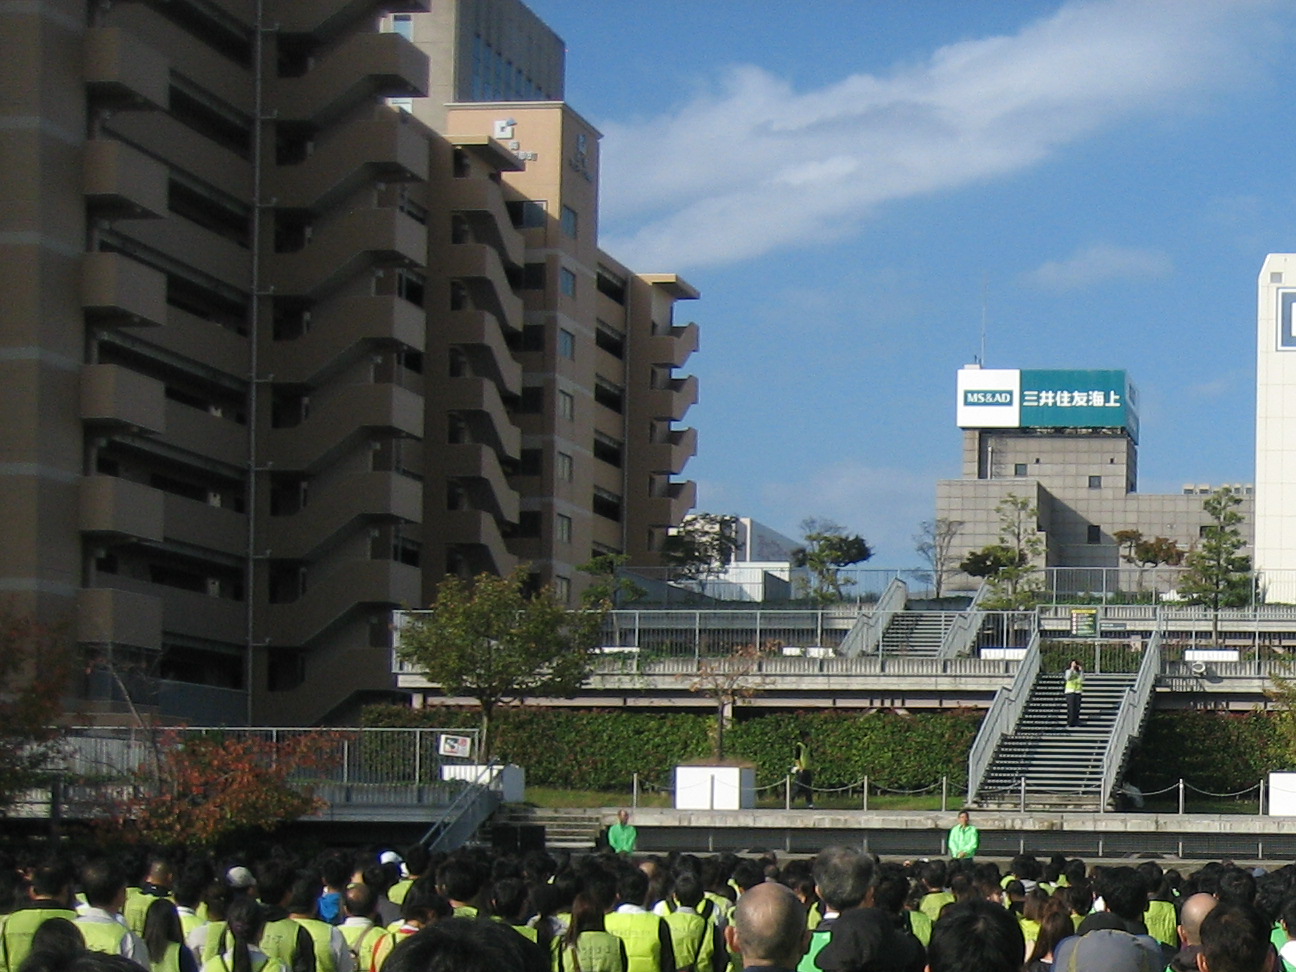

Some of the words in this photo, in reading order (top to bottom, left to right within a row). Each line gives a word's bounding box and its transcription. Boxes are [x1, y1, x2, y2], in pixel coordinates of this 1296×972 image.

[967, 392, 1011, 403] MS&AD
[1023, 390, 1121, 407] 三井住友海上
